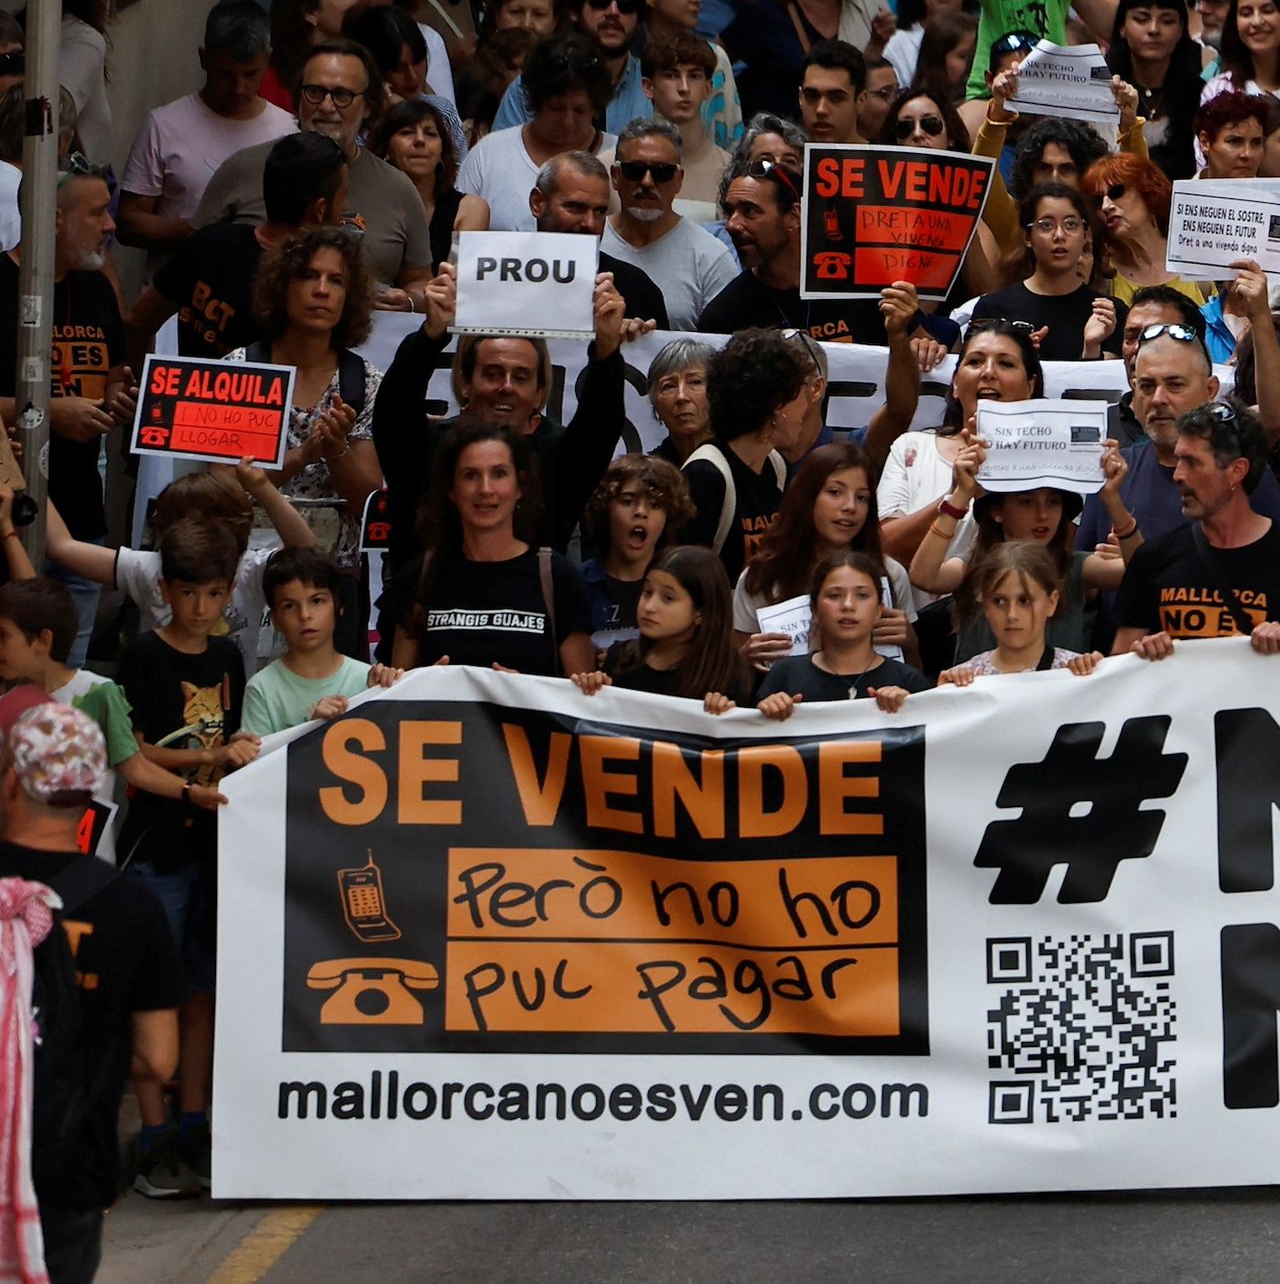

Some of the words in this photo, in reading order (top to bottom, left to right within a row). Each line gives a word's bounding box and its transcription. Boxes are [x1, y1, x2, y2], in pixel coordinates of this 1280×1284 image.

[1041, 62, 1075, 73] TECHO
[1049, 72, 1087, 84] FUTURO
[815, 157, 865, 198] SE
[877, 159, 987, 209] VENDE
[862, 210, 913, 229] DRET
[1177, 203, 1184, 215] SI
[1184, 204, 1199, 216] ENS
[1200, 205, 1227, 219] NEGUEN
[1228, 209, 1236, 221] EL
[1237, 210, 1265, 225] SOSTRE,
[1183, 220, 1197, 232] ENS
[1197, 221, 1225, 235] NEGUEN
[1225, 224, 1234, 236] EL
[1235, 225, 1257, 239] FUTUR
[1178, 234, 1194, 247] Dret
[1195, 239, 1201, 247] a
[1202, 240, 1213, 249] una
[1241, 243, 1258, 256] digna
[476, 257, 576, 283] PROU
[72, 346, 104, 365] ES
[151, 366, 182, 396] SE
[184, 369, 282, 406] ALQUILA
[199, 406, 218, 424] NO
[224, 409, 242, 425] HO
[249, 412, 274, 428] PUC
[180, 433, 244, 450] LLOGAR
[994, 427, 1013, 436] SIN
[1015, 426, 1052, 436] TECHO
[995, 441, 1021, 450] HAY
[1023, 441, 1067, 451] FUTURO
[493, 614, 545, 630] GUAJES
[1165, 609, 1206, 631] NO
[318, 719, 463, 825] SE
[502, 723, 884, 838] VENDE
[455, 855, 623, 929] Però
[651, 876, 740, 927] no
[778, 866, 880, 937] ho
[463, 958, 594, 1031] puc
[638, 954, 861, 1032] pagar
[278, 1068, 930, 1121] mallorcanoesven.com
